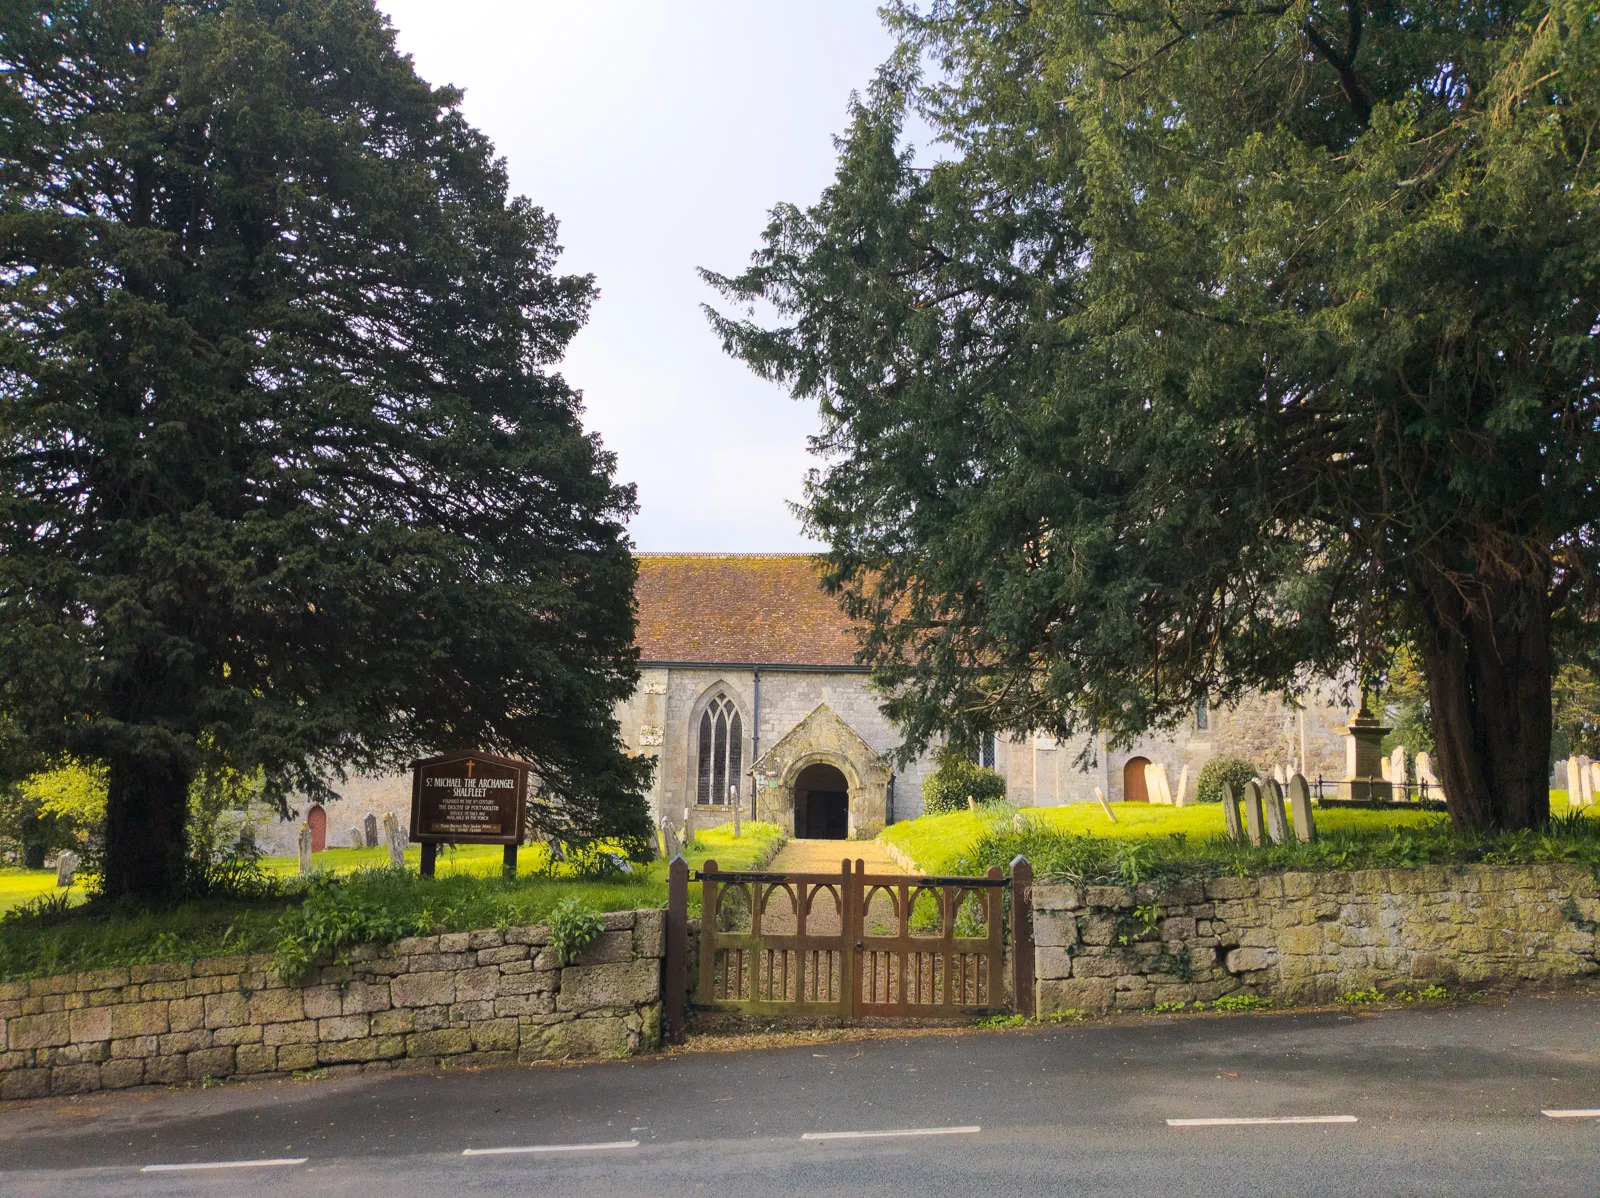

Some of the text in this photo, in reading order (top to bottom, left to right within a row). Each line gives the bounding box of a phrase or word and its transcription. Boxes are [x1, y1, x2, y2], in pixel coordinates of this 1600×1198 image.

[434, 778, 462, 788] MICHAEL
[464, 778, 477, 788] THE
[478, 779, 515, 789] ARCHANGEL
[453, 787, 487, 798] SHALFLEET
